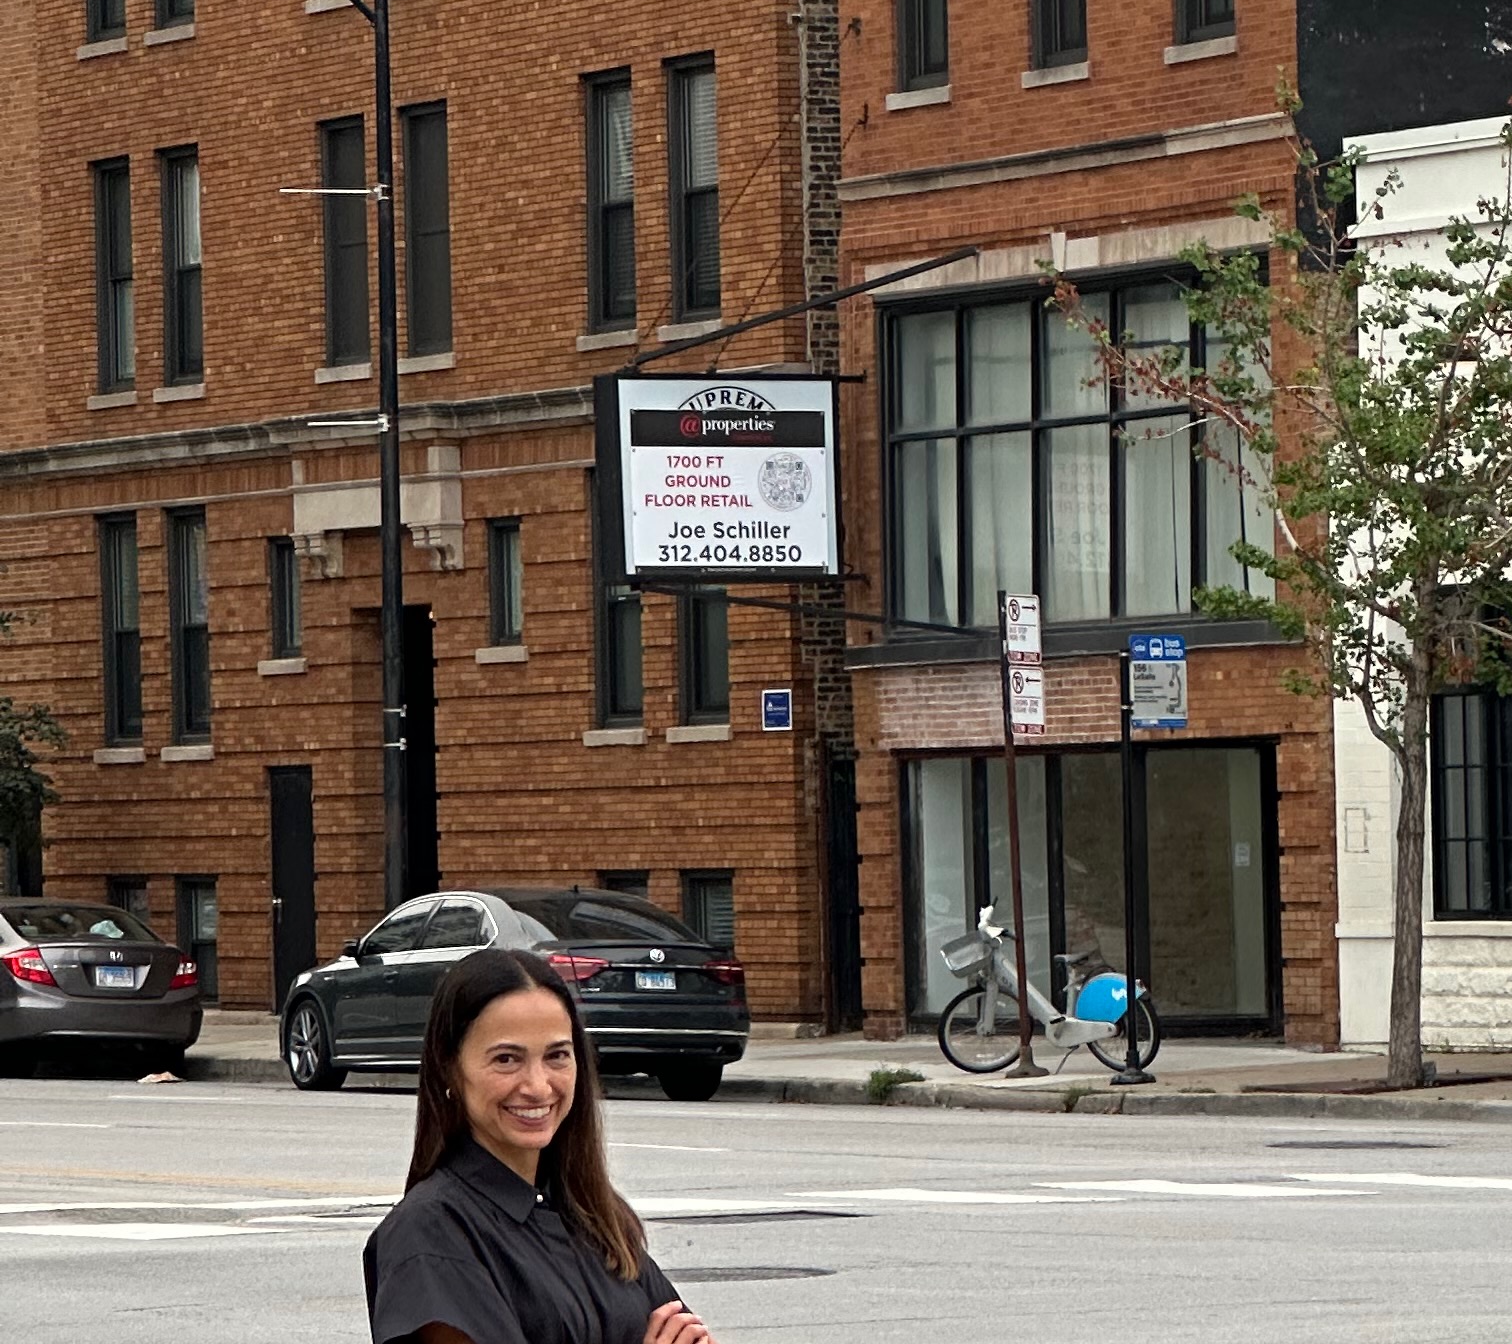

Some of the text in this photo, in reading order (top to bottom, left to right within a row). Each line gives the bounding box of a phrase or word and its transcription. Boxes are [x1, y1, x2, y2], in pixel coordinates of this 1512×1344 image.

[688, 389, 765, 411] UPREM
[667, 455, 724, 468] 1700 FT
[665, 475, 731, 488] GROUND
[645, 494, 753, 508] FLOOR RETAIL
[668, 520, 791, 539] Joe Schiller
[658, 544, 802, 563] 312.404.8850
